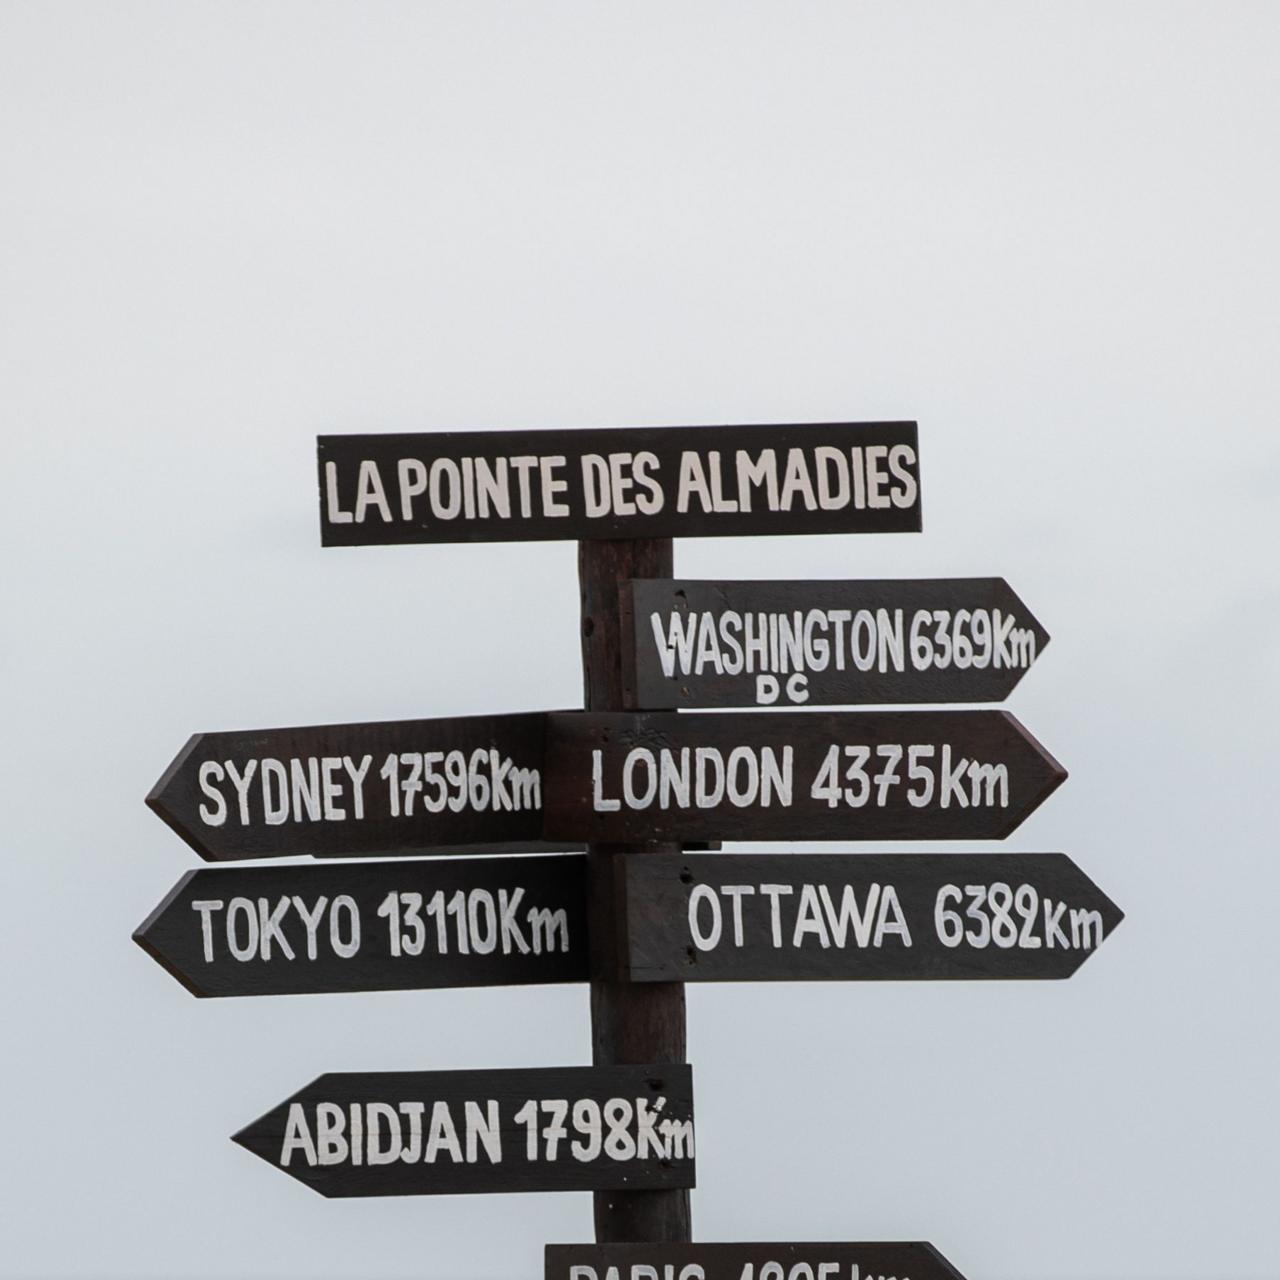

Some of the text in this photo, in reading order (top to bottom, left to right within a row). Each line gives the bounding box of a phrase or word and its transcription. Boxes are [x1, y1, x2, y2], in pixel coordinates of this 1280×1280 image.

[326, 444, 917, 524] LA POINTE DES ALMADIES
[650, 607, 905, 678] WASHINGTON
[198, 754, 373, 827] SYDNEY
[592, 745, 794, 812] LONDON
[191, 894, 361, 963] TOKYO
[687, 882, 913, 952] OTTAWA
[280, 1100, 502, 1167] ABIDJAN
